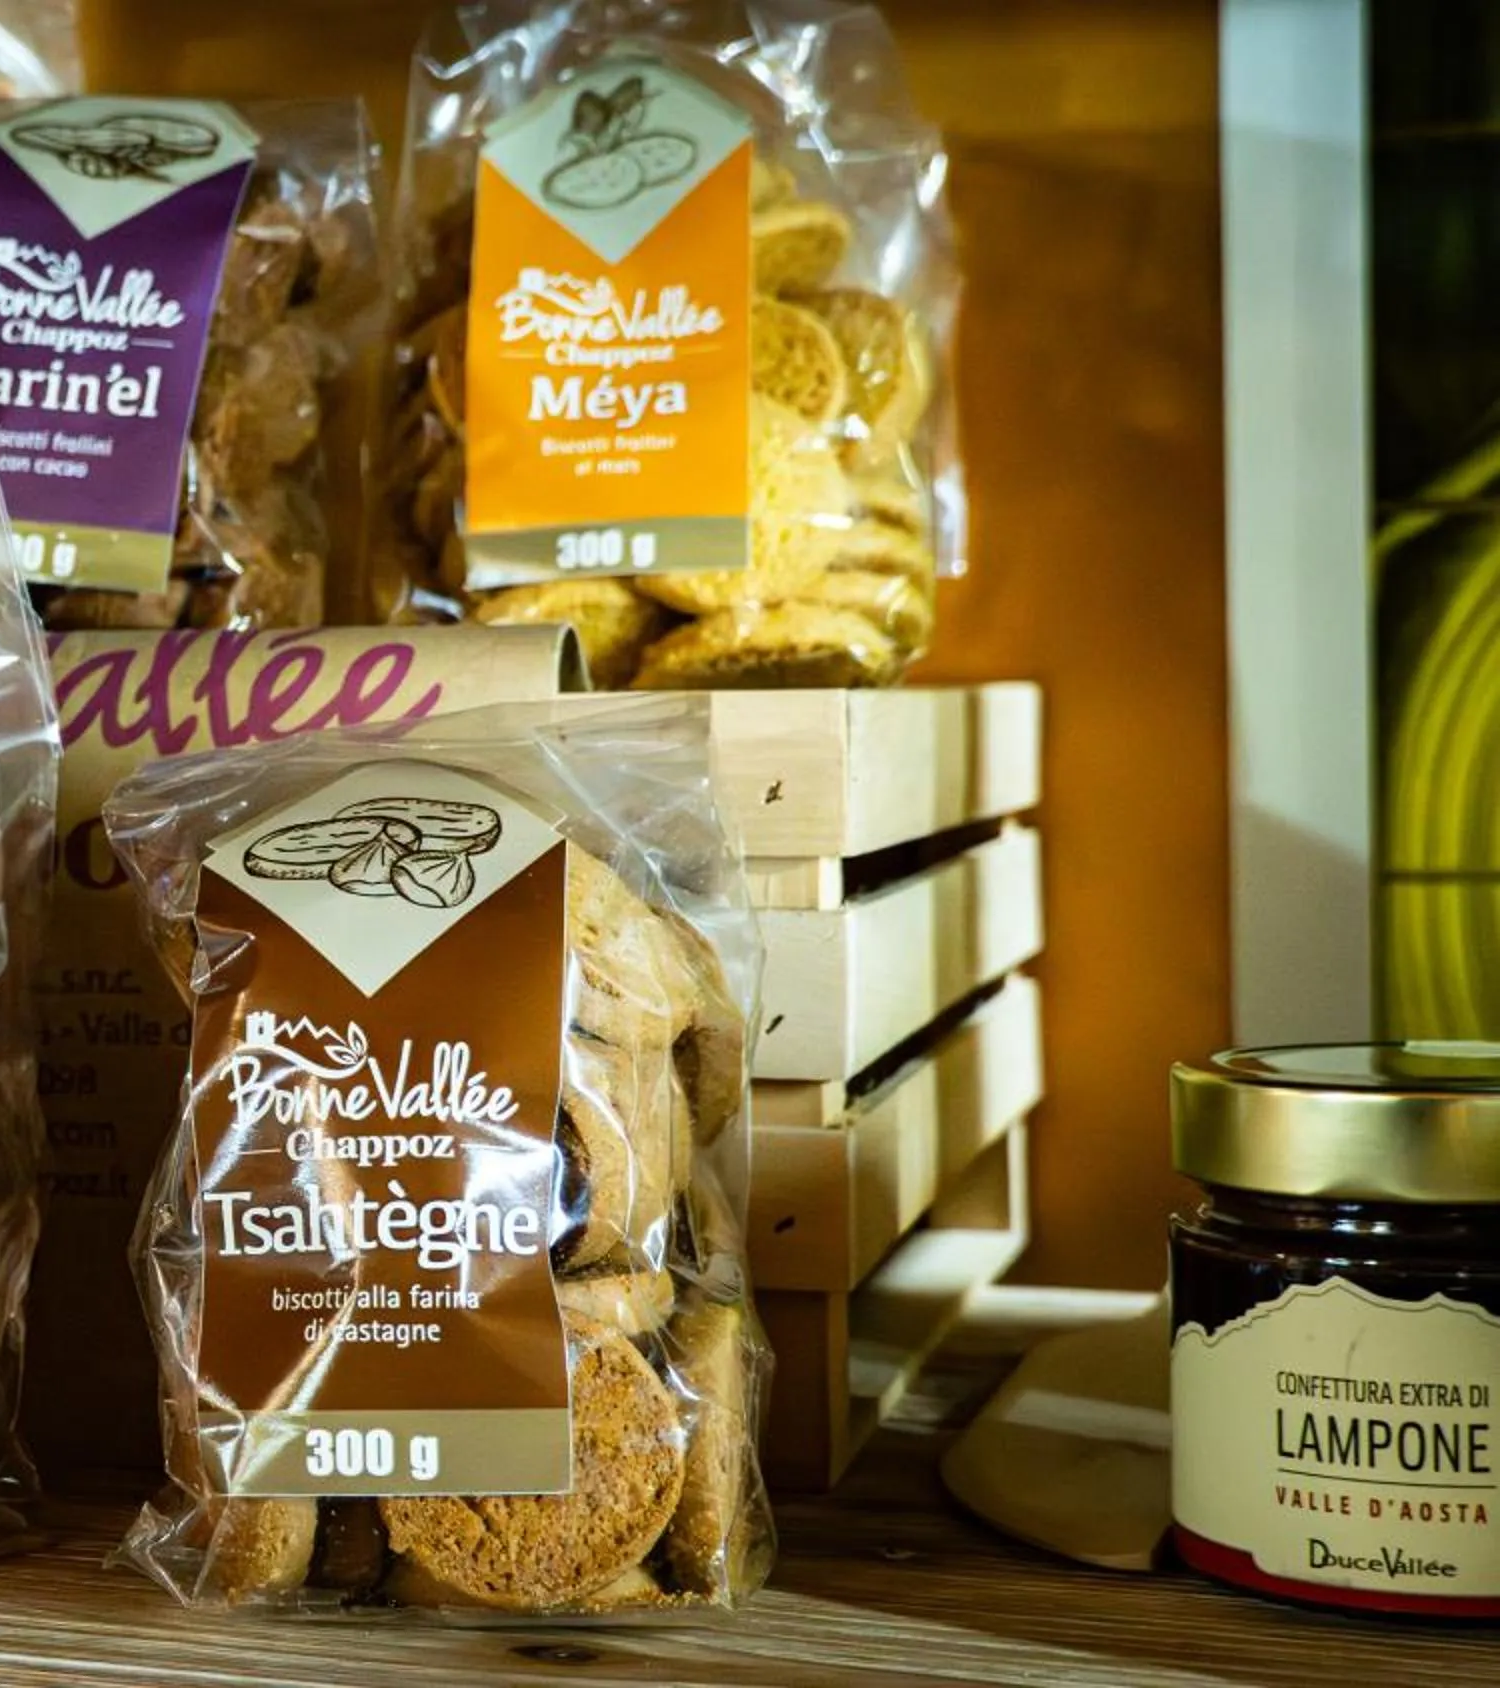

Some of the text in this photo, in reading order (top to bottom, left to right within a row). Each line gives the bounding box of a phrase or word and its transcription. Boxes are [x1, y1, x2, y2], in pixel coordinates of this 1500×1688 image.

[1, 318, 129, 353] Chappoz
[527, 374, 688, 428] Méya
[33, 457, 89, 478] cacao
[556, 528, 657, 570] 300 g
[48, 629, 441, 755] allée
[79, 1009, 162, 1045] Valle
[286, 1127, 455, 1167] Chappoz
[272, 1284, 481, 1311] biscotti alla farina
[304, 1318, 441, 1348] di castagne
[1276, 1371, 1489, 1408] CONFETTURA EXTRA DI
[305, 1428, 440, 1481] 300 g
[1276, 1408, 1491, 1473] LAMPONE
[1275, 1486, 1488, 1524] VALLE D'AOSTA
